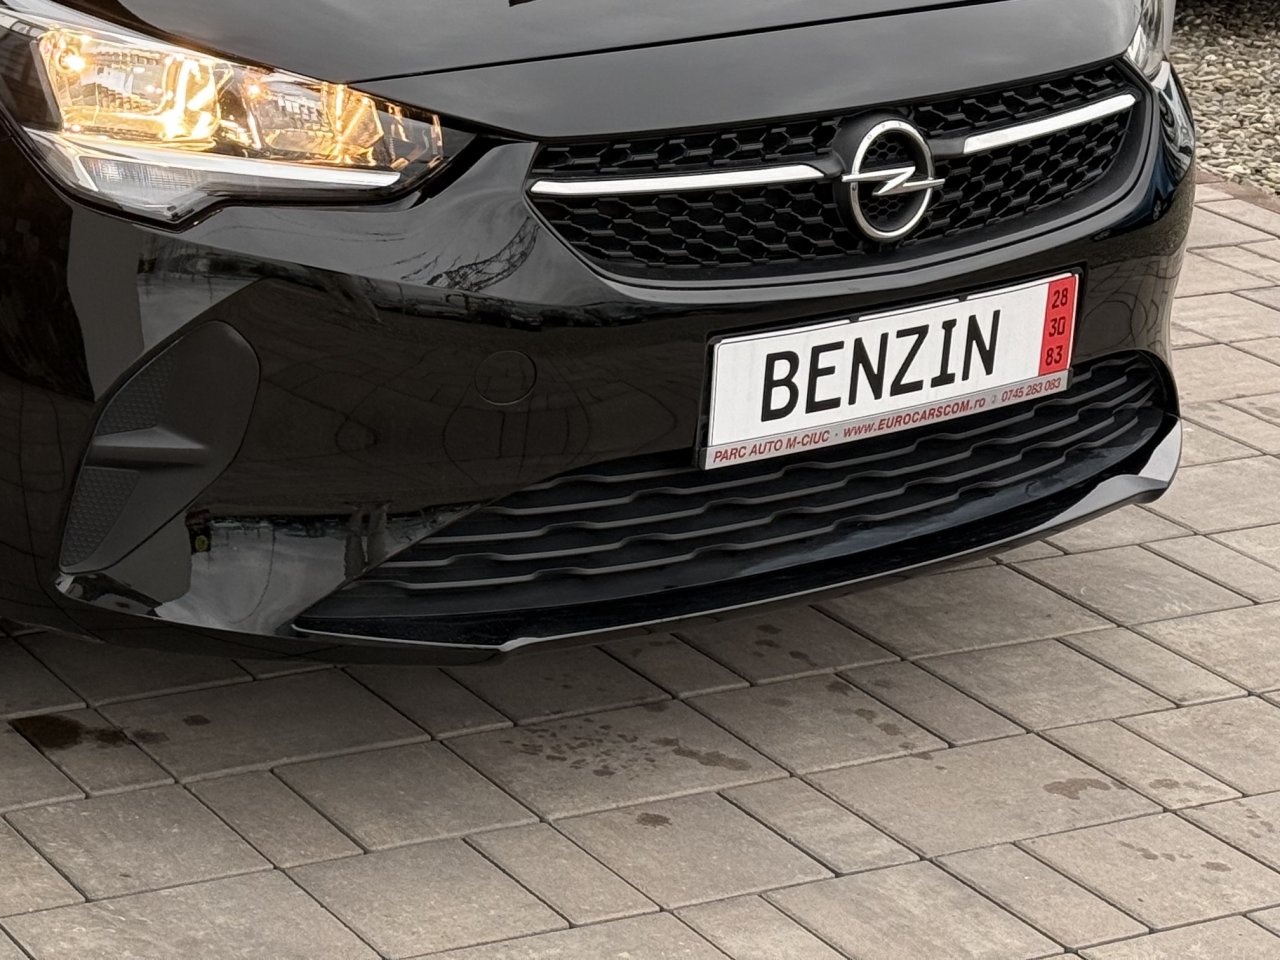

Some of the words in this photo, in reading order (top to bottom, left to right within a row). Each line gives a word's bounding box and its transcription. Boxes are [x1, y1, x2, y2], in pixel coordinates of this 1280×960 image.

[1052, 287, 1068, 309] 28
[1048, 316, 1066, 337] 30
[760, 309, 1001, 422] BENZIN
[1045, 345, 1063, 366] 83
[713, 446, 747, 463] PARC
[749, 439, 782, 456] AUTO
[785, 430, 830, 450] M-CIUC
[1001, 386, 1024, 402] 0745
